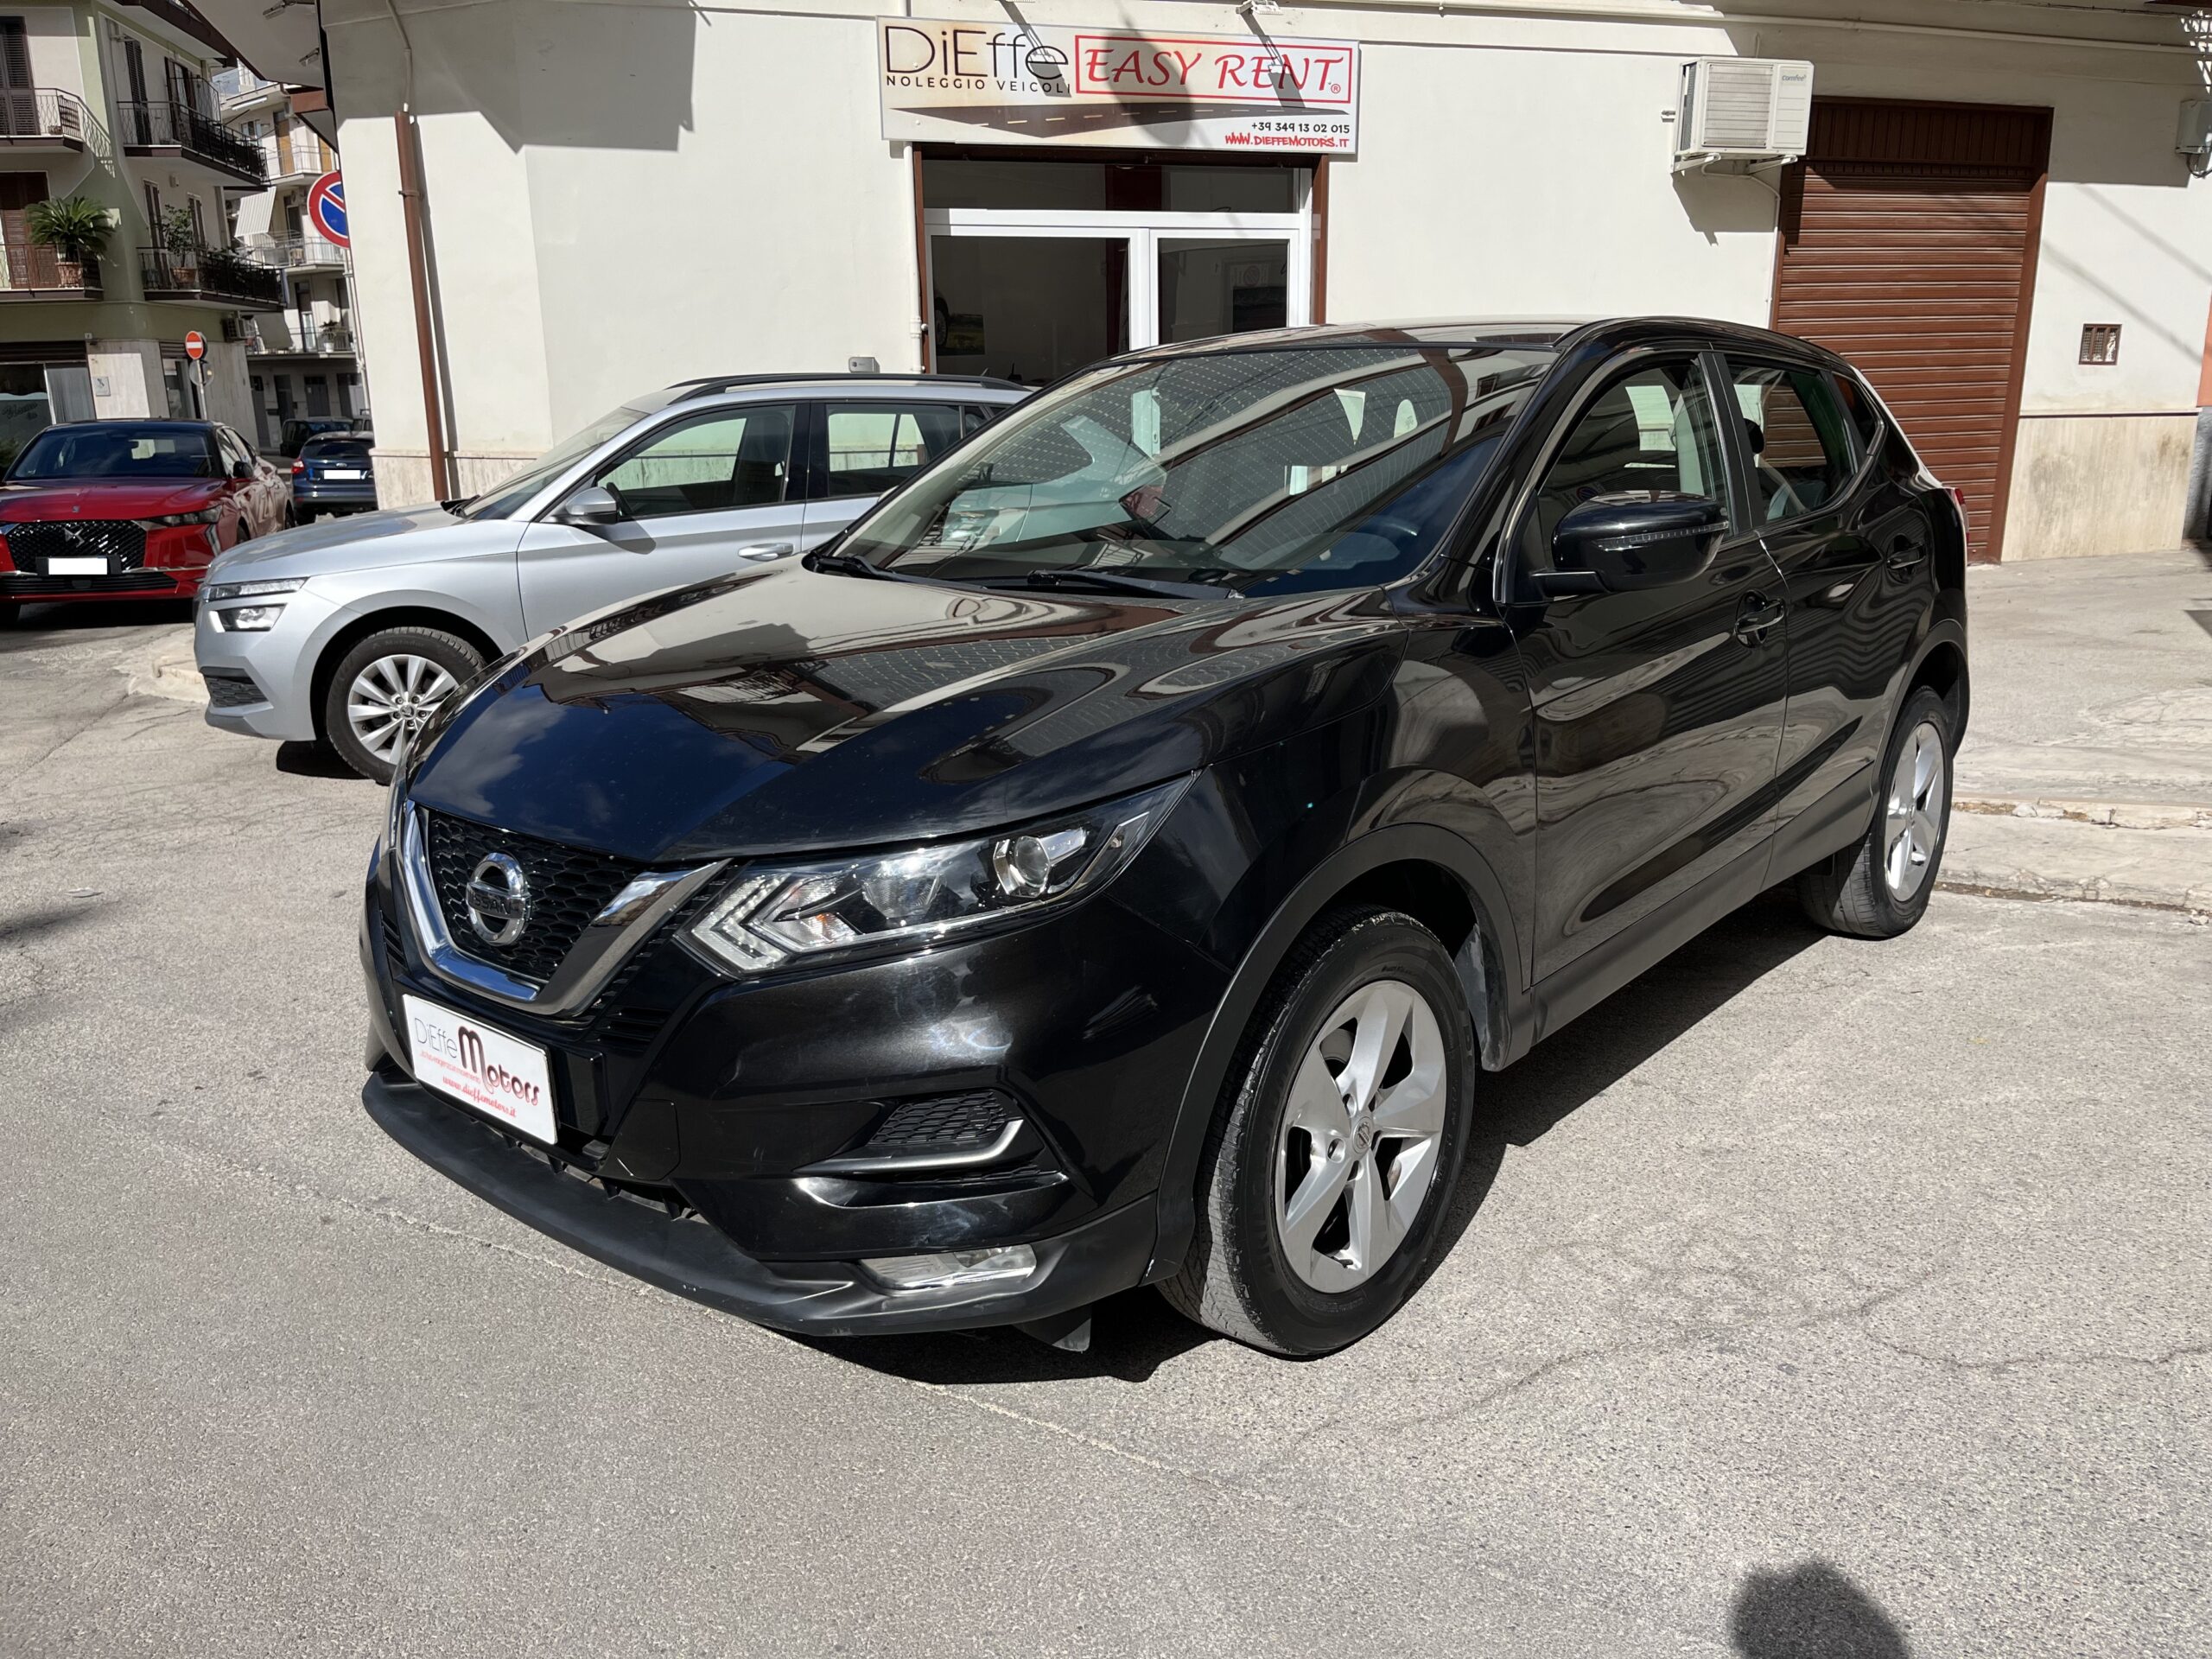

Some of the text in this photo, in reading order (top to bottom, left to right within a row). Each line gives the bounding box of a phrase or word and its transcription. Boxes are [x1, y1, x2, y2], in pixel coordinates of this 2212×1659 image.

[885, 25, 1069, 79] DiEffe
[1084, 48, 1202, 85] EASY
[886, 75, 1071, 94] NOLEGGIO VEICOLI
[1224, 131, 1350, 148] WWW.DIEFFEMOTORS.IT
[1251, 122, 1351, 134] +39 349 13 02 015
[414, 1017, 458, 1059] DiEffe
[442, 1076, 517, 1118] www.dieffemotors.it
